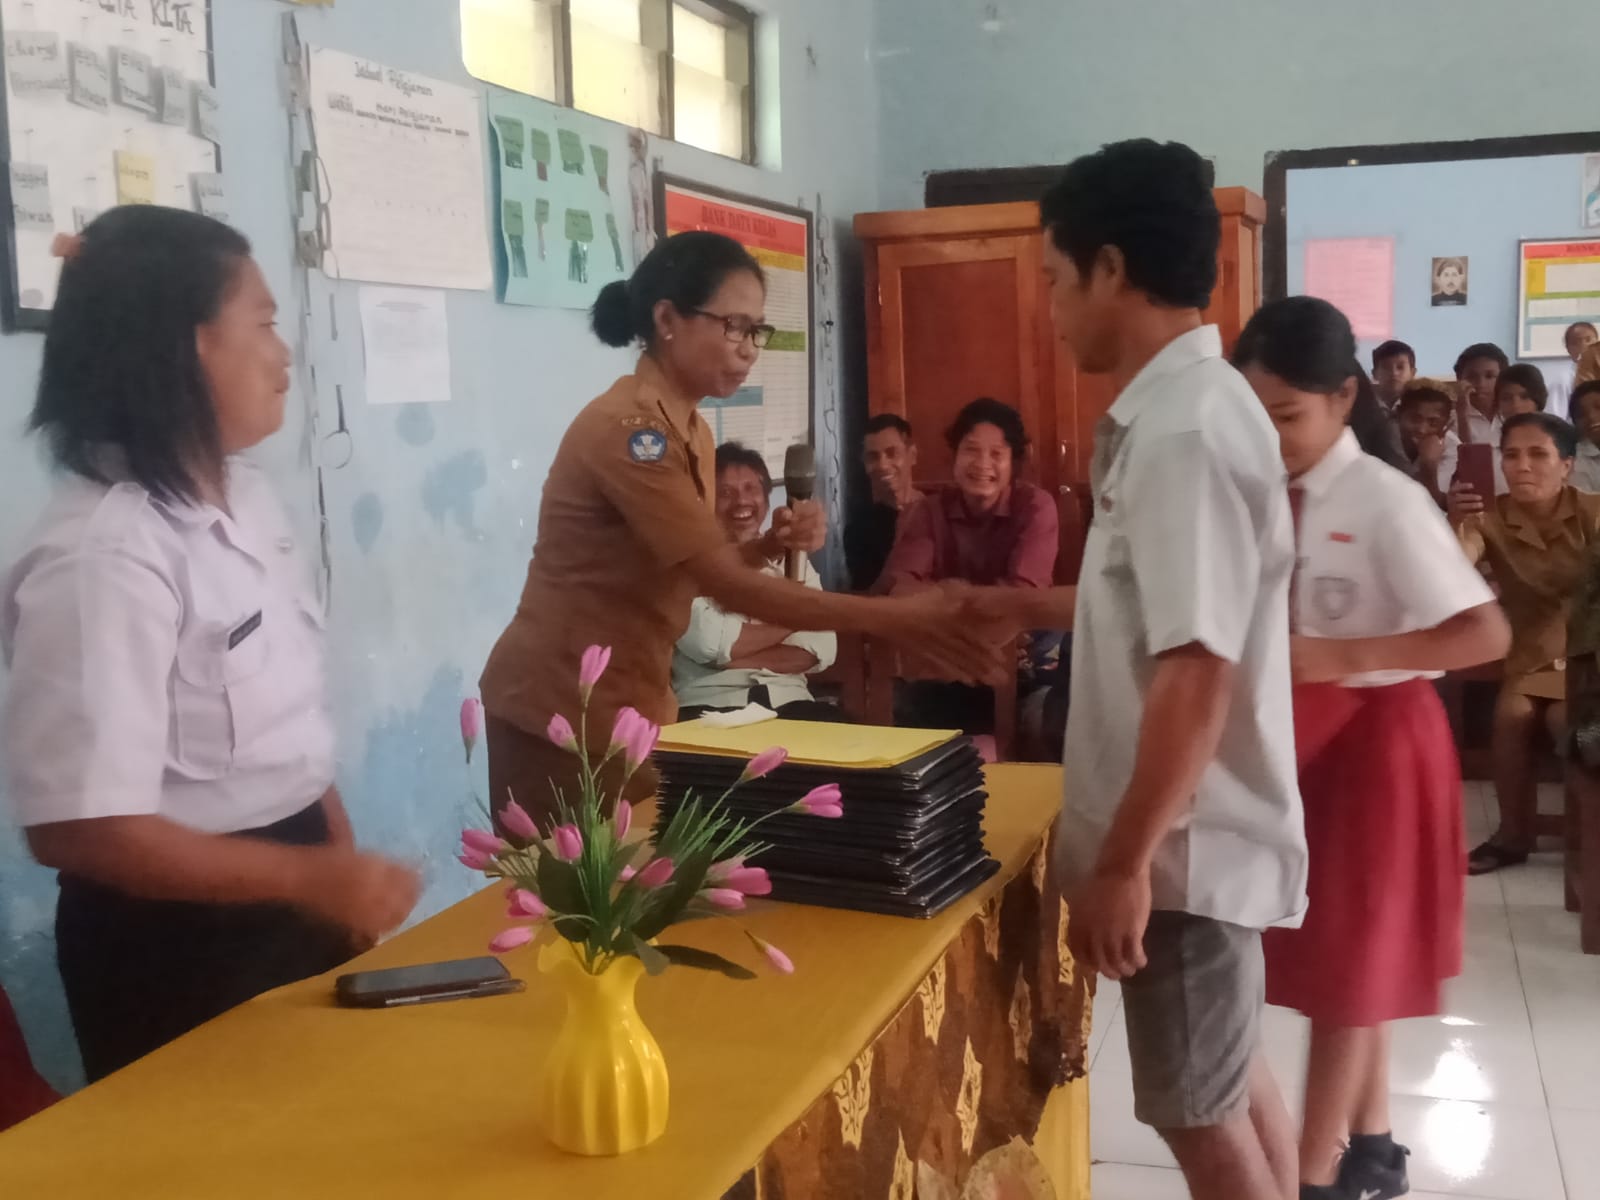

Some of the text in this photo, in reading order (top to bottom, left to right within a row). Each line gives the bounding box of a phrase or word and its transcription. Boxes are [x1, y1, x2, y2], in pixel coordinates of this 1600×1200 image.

[151, 0, 194, 35] KITA
[702, 206, 726, 227] BANK
[727, 211, 751, 233] DATA
